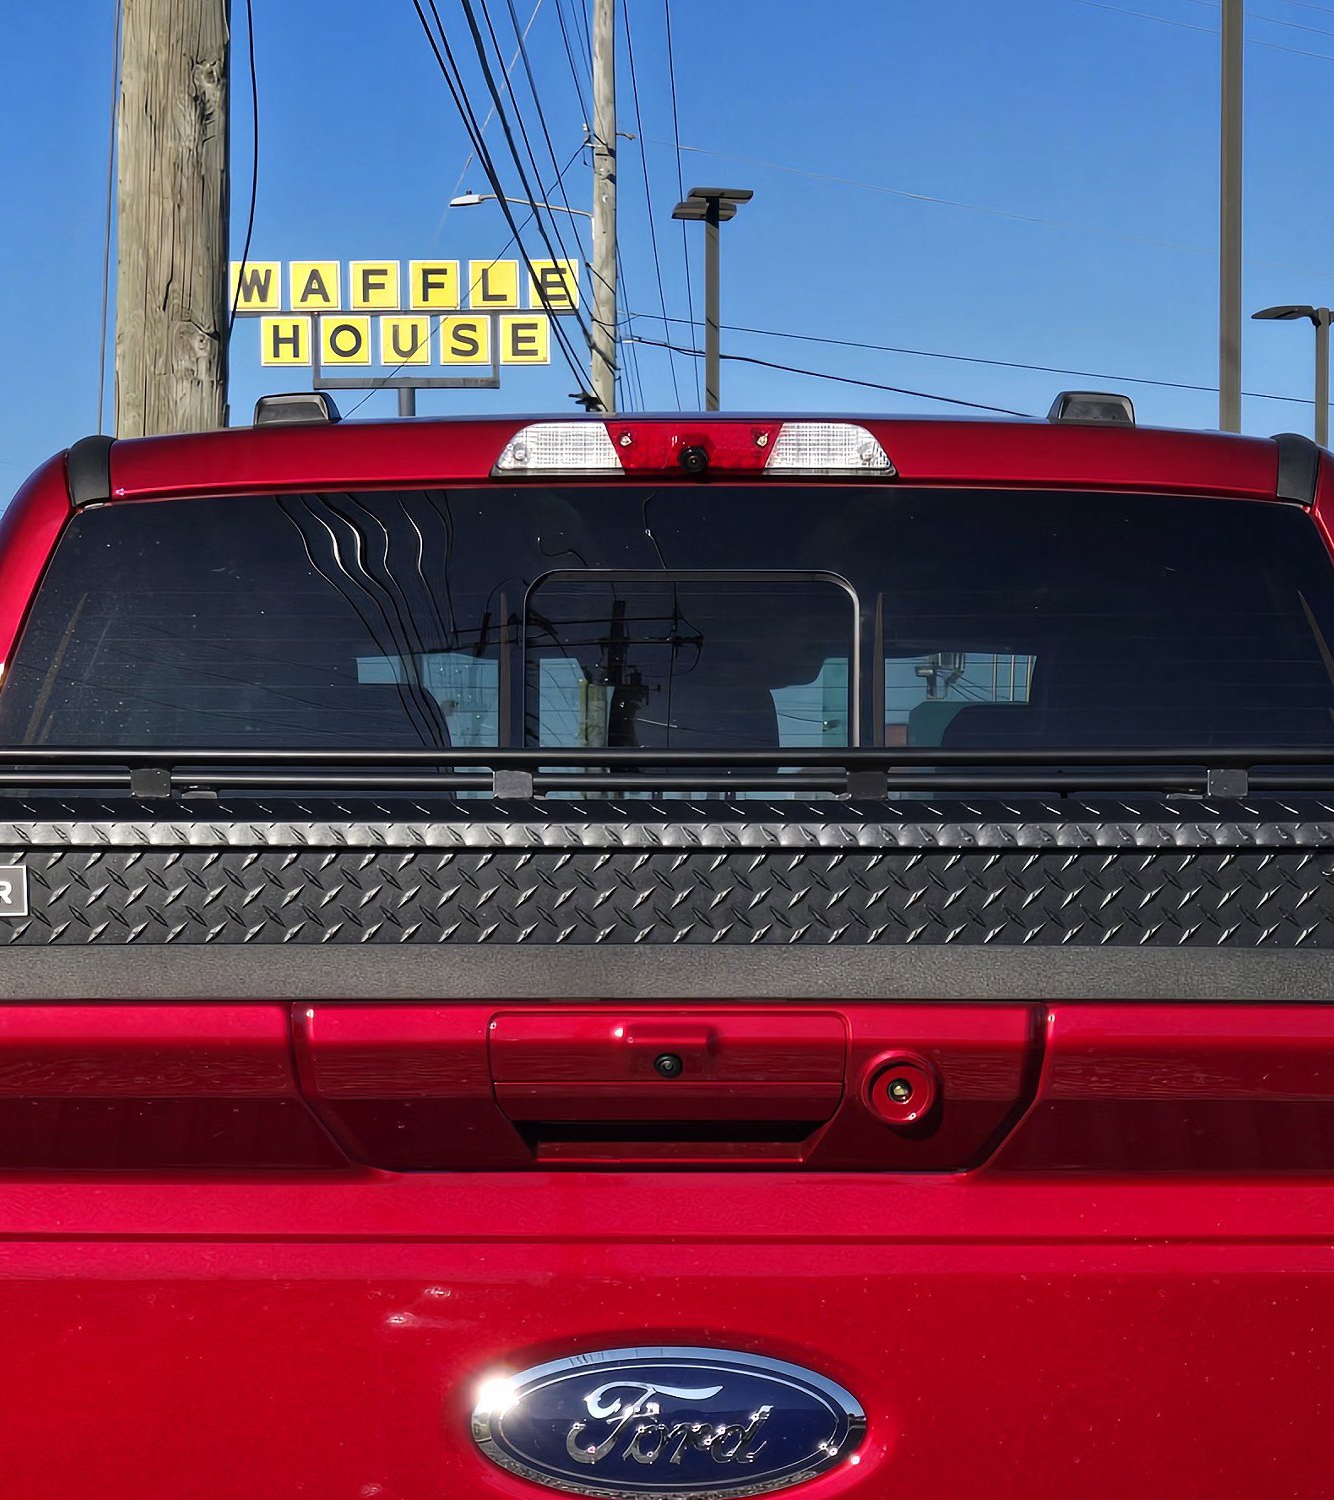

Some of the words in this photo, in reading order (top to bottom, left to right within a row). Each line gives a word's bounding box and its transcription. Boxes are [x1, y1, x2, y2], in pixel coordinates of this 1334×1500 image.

[241, 266, 568, 303] WAFFLE
[272, 323, 539, 358] HOUSE
[566, 1380, 774, 1464] Ford
